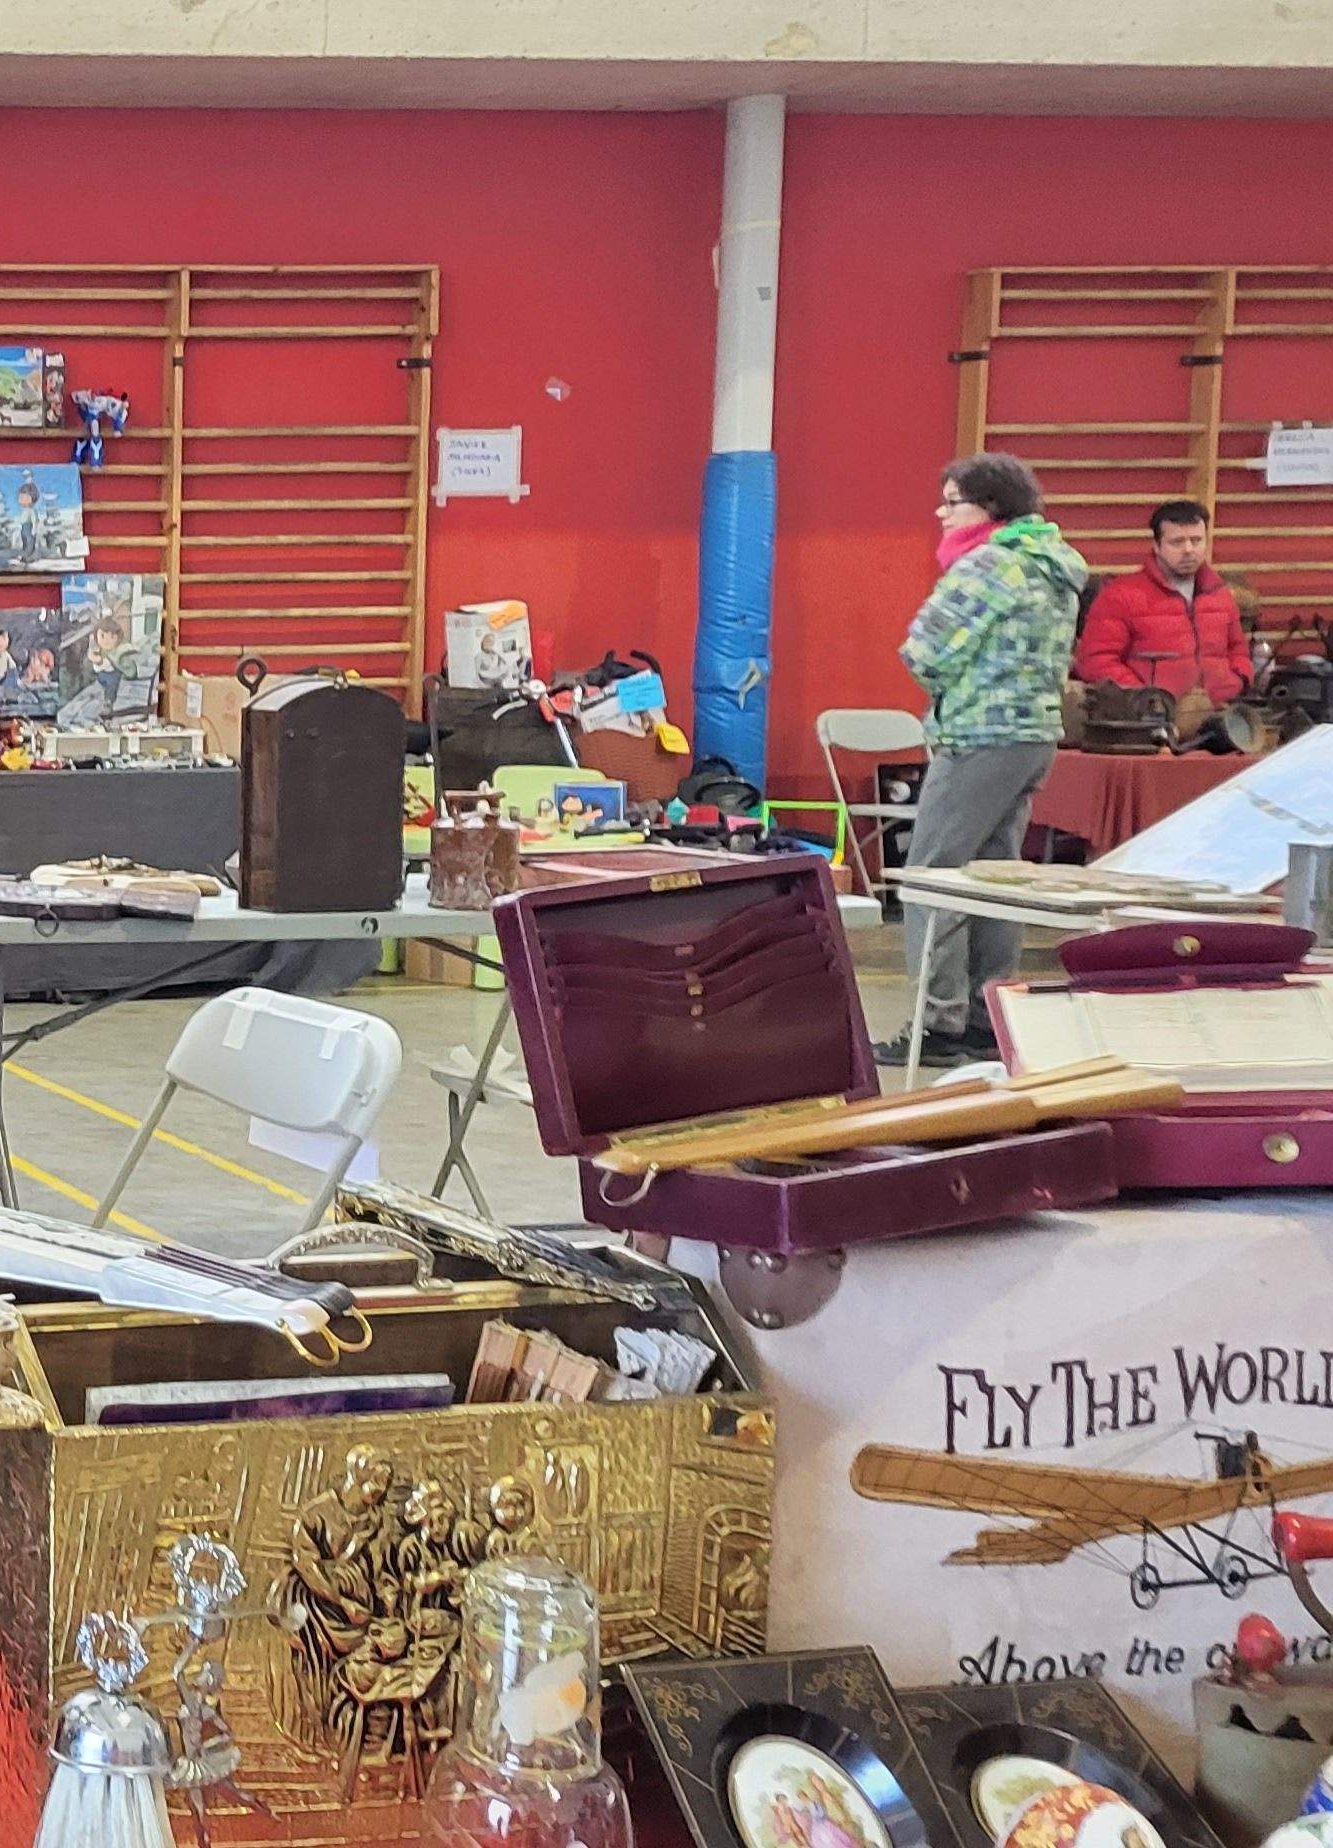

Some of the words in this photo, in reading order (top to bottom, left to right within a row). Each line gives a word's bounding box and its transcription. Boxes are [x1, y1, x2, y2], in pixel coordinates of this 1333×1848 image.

[938, 1363, 1042, 1454] FLY
[1051, 1359, 1159, 1448] THE
[1173, 1342, 1333, 1416] WORL
[1124, 1637, 1185, 1677] the
